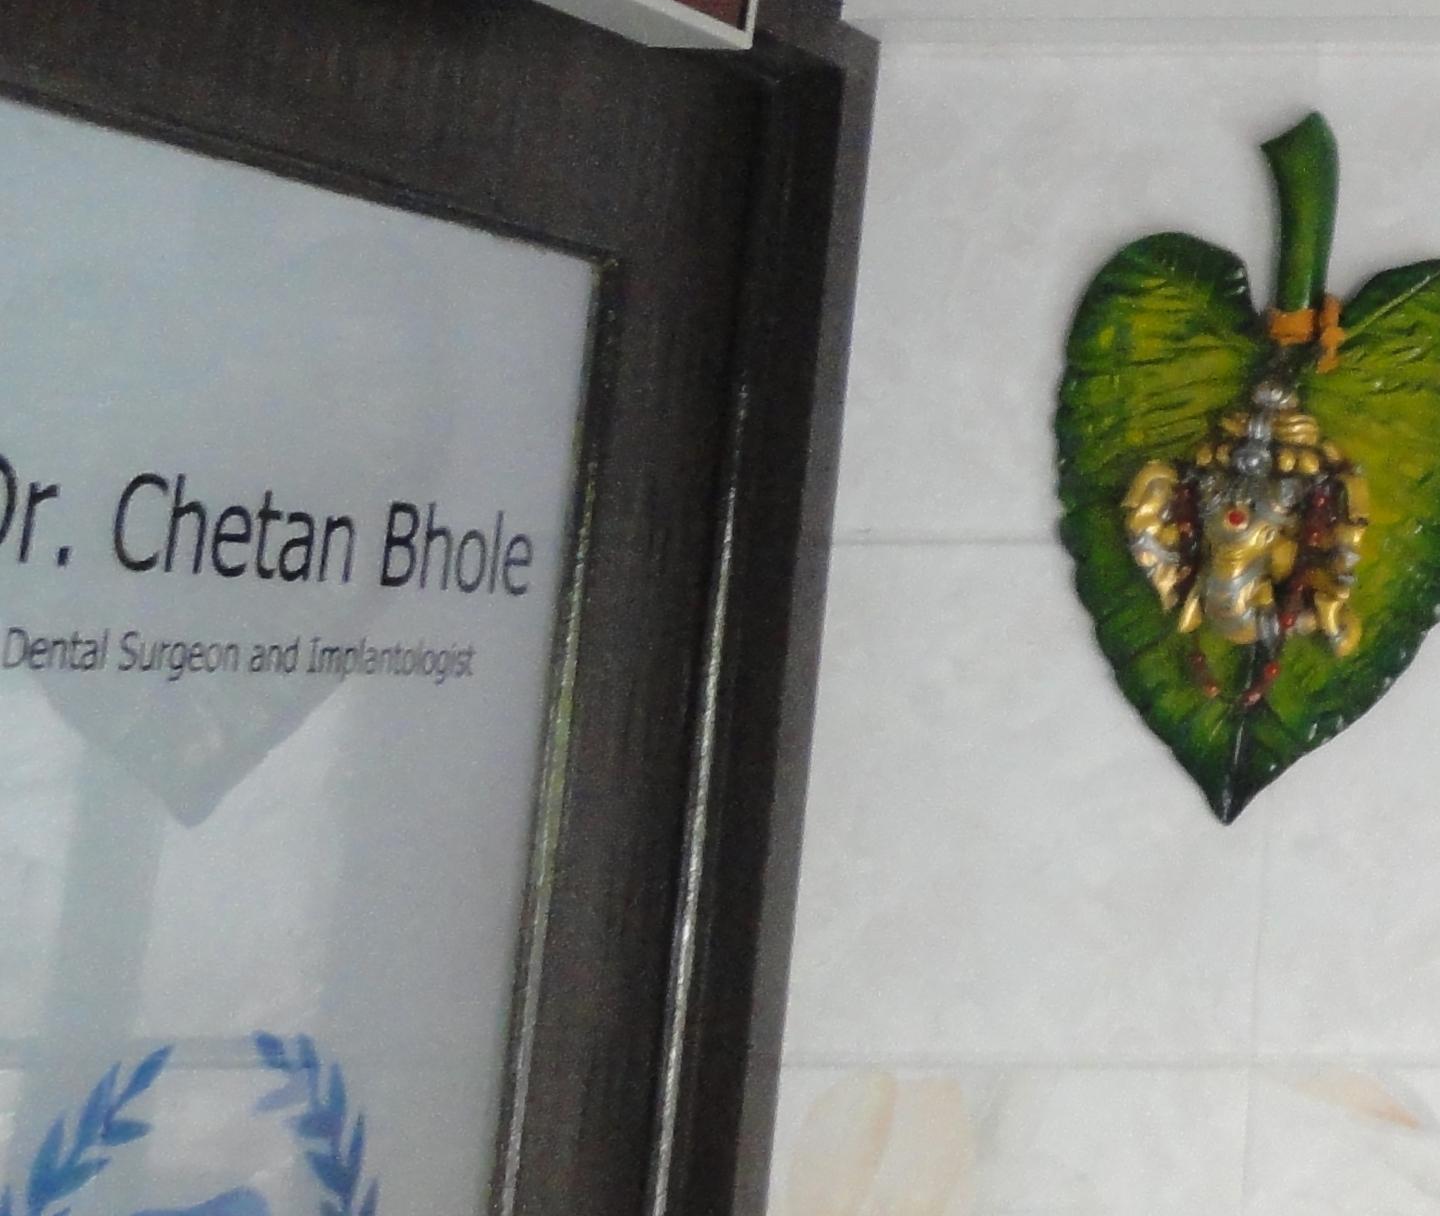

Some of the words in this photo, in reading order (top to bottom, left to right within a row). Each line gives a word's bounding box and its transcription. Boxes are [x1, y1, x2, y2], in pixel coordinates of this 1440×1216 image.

[113, 472, 356, 584] Chetan
[379, 501, 534, 596] Bhole
[3, 626, 109, 672] Dental
[119, 629, 240, 681] Surgeon
[250, 636, 299, 675] and
[306, 636, 477, 684] Implantologist
